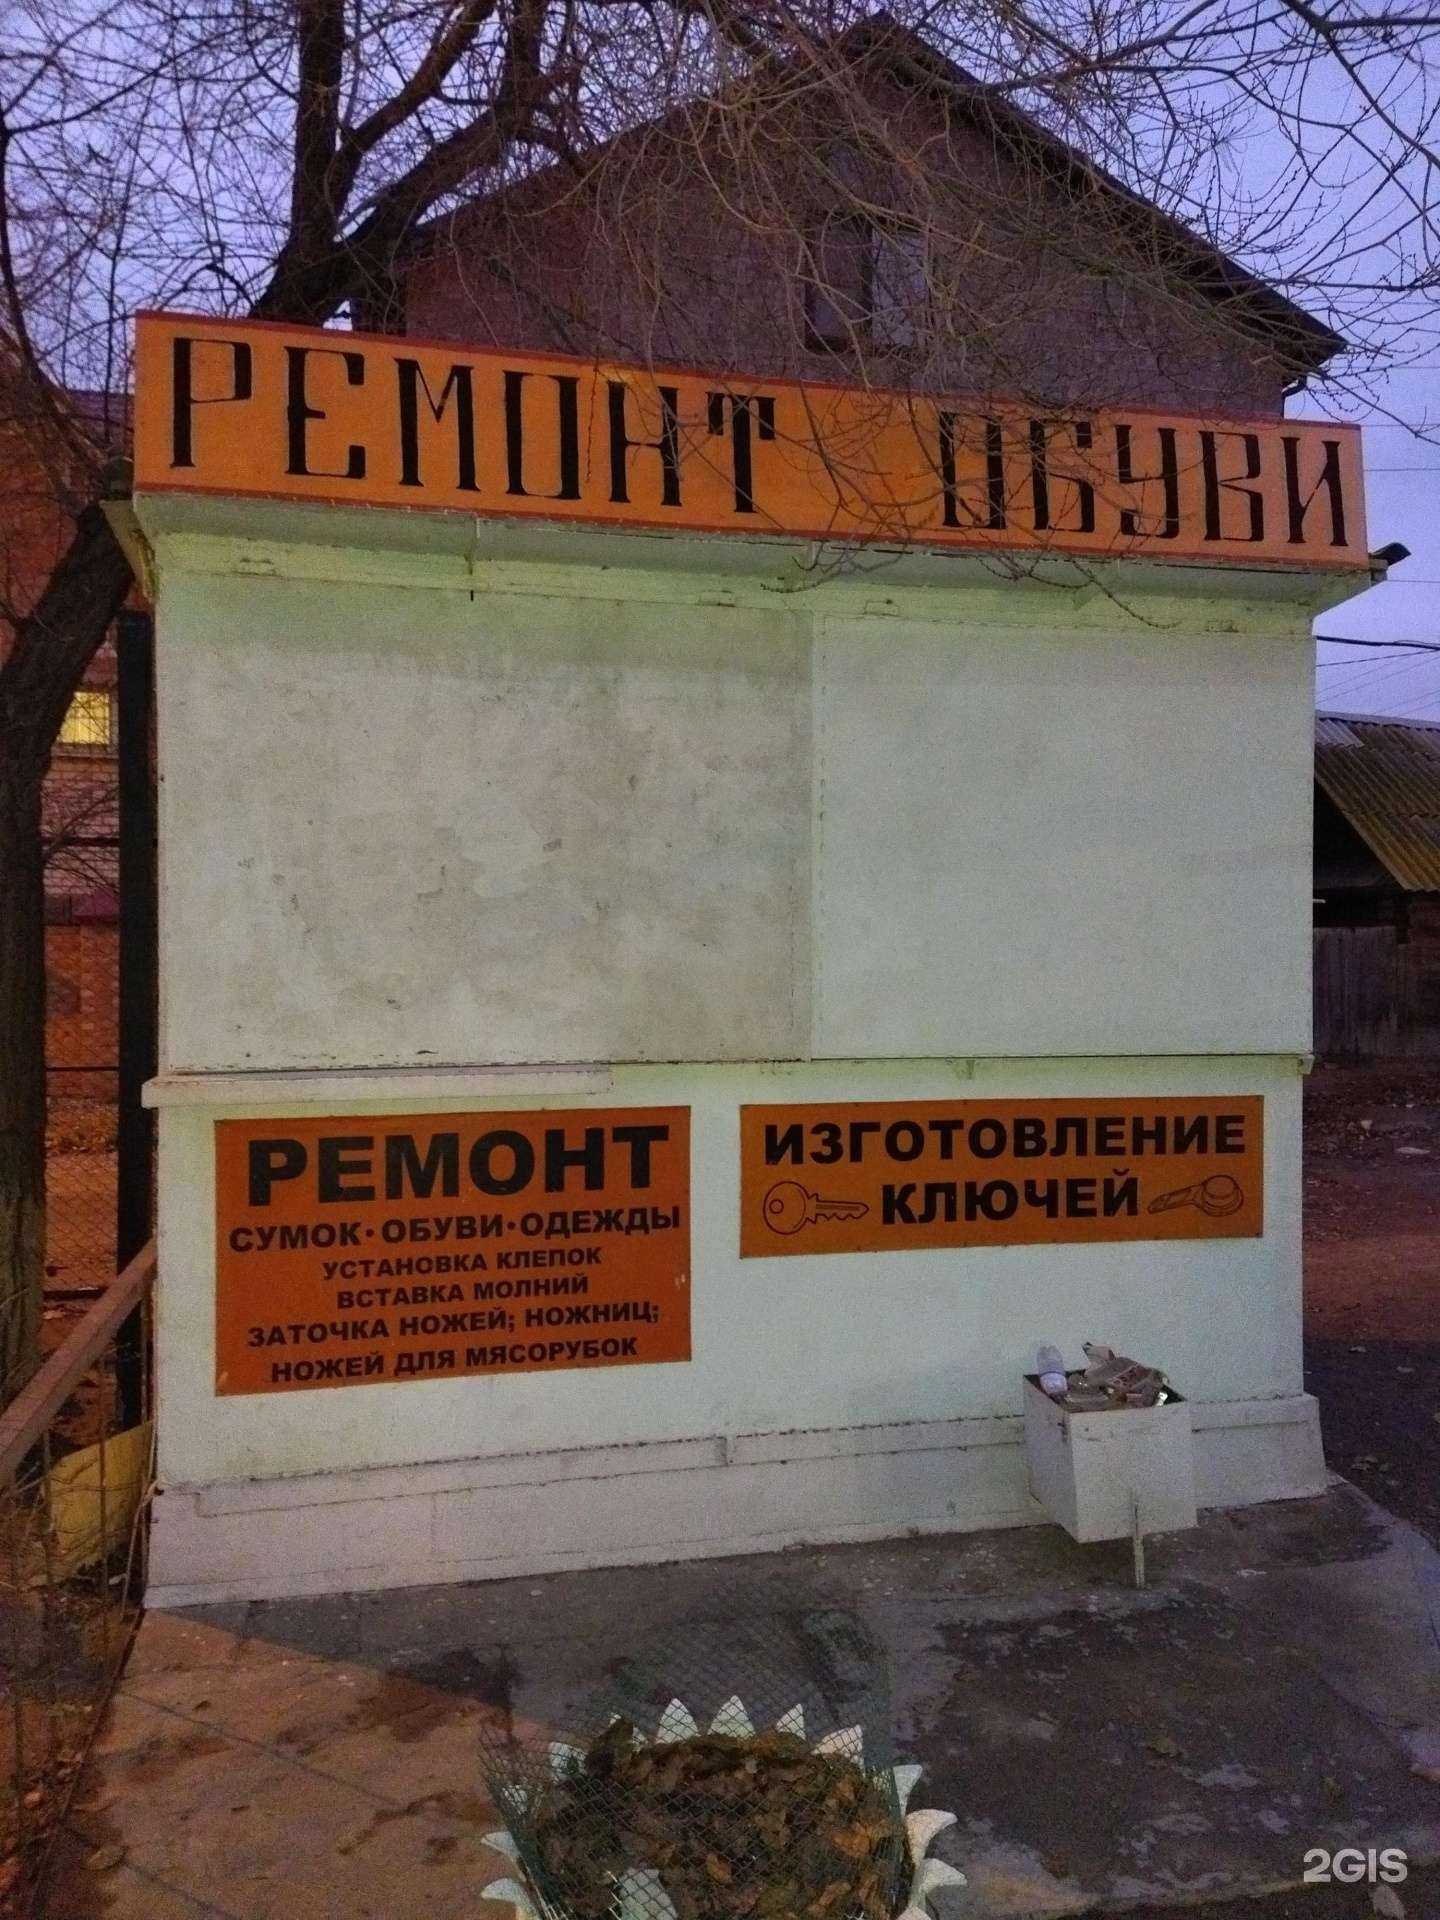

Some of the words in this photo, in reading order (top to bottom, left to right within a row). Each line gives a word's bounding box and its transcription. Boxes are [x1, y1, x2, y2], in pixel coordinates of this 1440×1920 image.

[170, 337, 775, 513] РЕМОНТ
[939, 411, 1349, 547] ОБУВИ
[764, 1115, 1246, 1165] ИЗГОТОВЛЕНИЕ
[248, 1125, 669, 1207] РЕМОНТ
[881, 1168, 1140, 1225] КЛЮЧЕЙ
[229, 1222, 361, 1253] СУМОК
[382, 1214, 502, 1245] ОБУВИ
[520, 1206, 680, 1237] ОДЕЖДЫ
[322, 1251, 488, 1280] УСТАНОВКА
[496, 1247, 602, 1269] КЛЕПОК
[337, 1281, 465, 1310] ВСТАВКА
[473, 1272, 588, 1301] МОЛНИЙ
[247, 1320, 389, 1347] ЗАТОЧКА
[399, 1306, 516, 1336] НОЖЕЙ;
[525, 1301, 660, 1328] НОЖНИЦ;
[271, 1350, 384, 1383] НОЖЕЙ
[393, 1349, 455, 1378] ДЛЯ
[465, 1337, 638, 1368] МЯСОРУБОК
